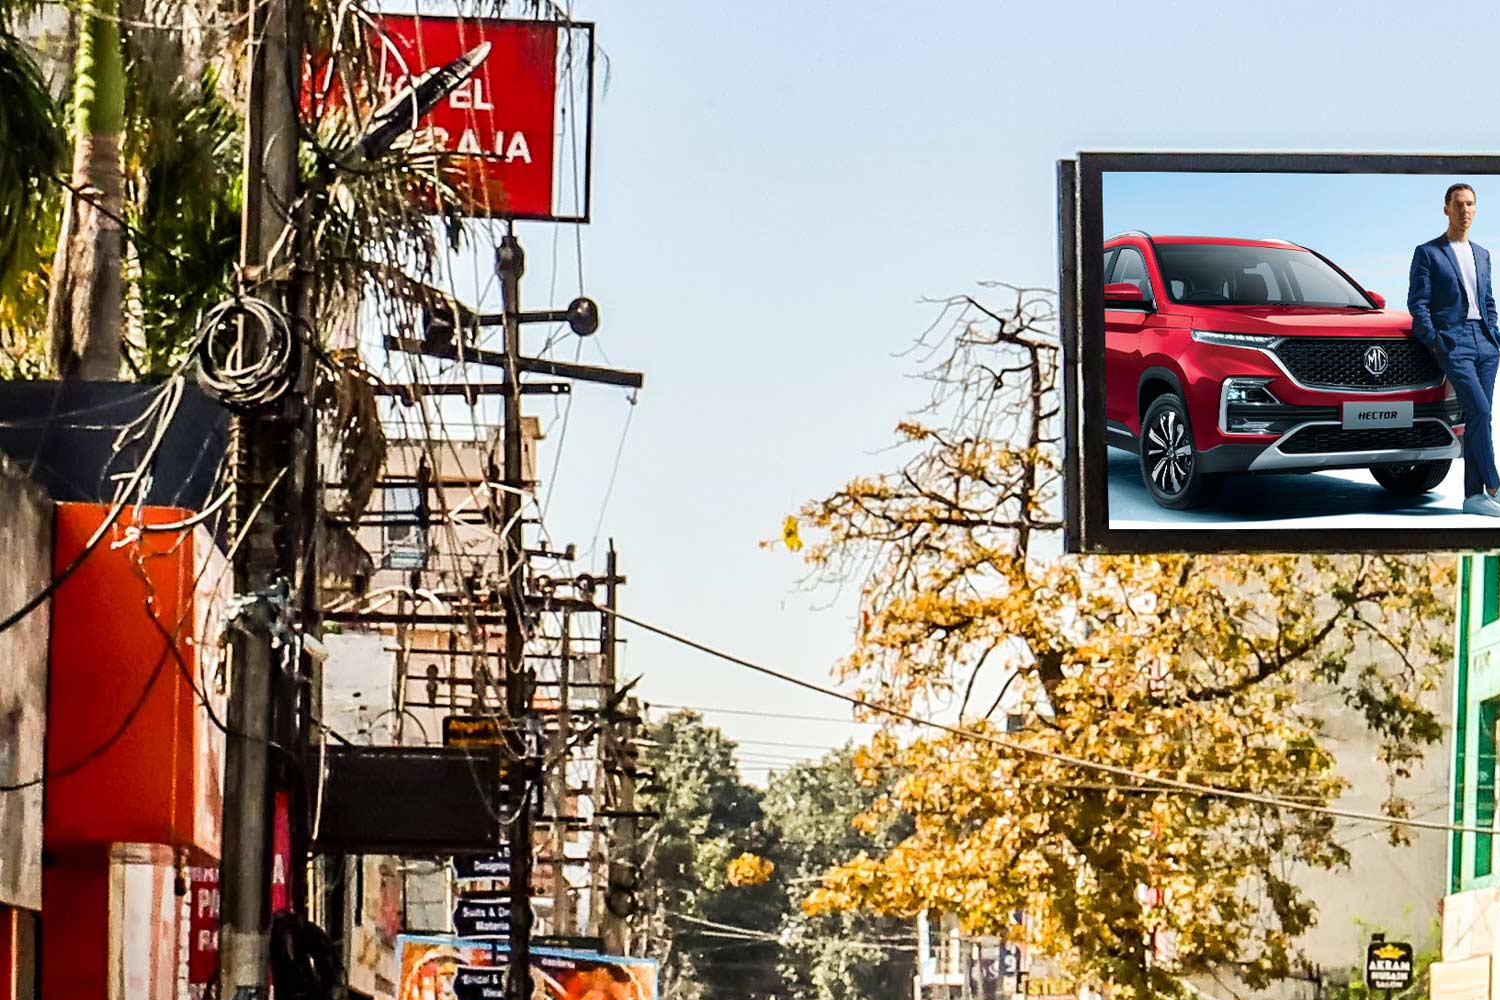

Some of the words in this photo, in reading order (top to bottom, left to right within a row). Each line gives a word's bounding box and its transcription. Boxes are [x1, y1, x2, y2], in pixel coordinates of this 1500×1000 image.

[1358, 411, 1398, 420] HECTOR
[476, 921, 510, 931] Materia
[1368, 960, 1411, 971] AKRAM
